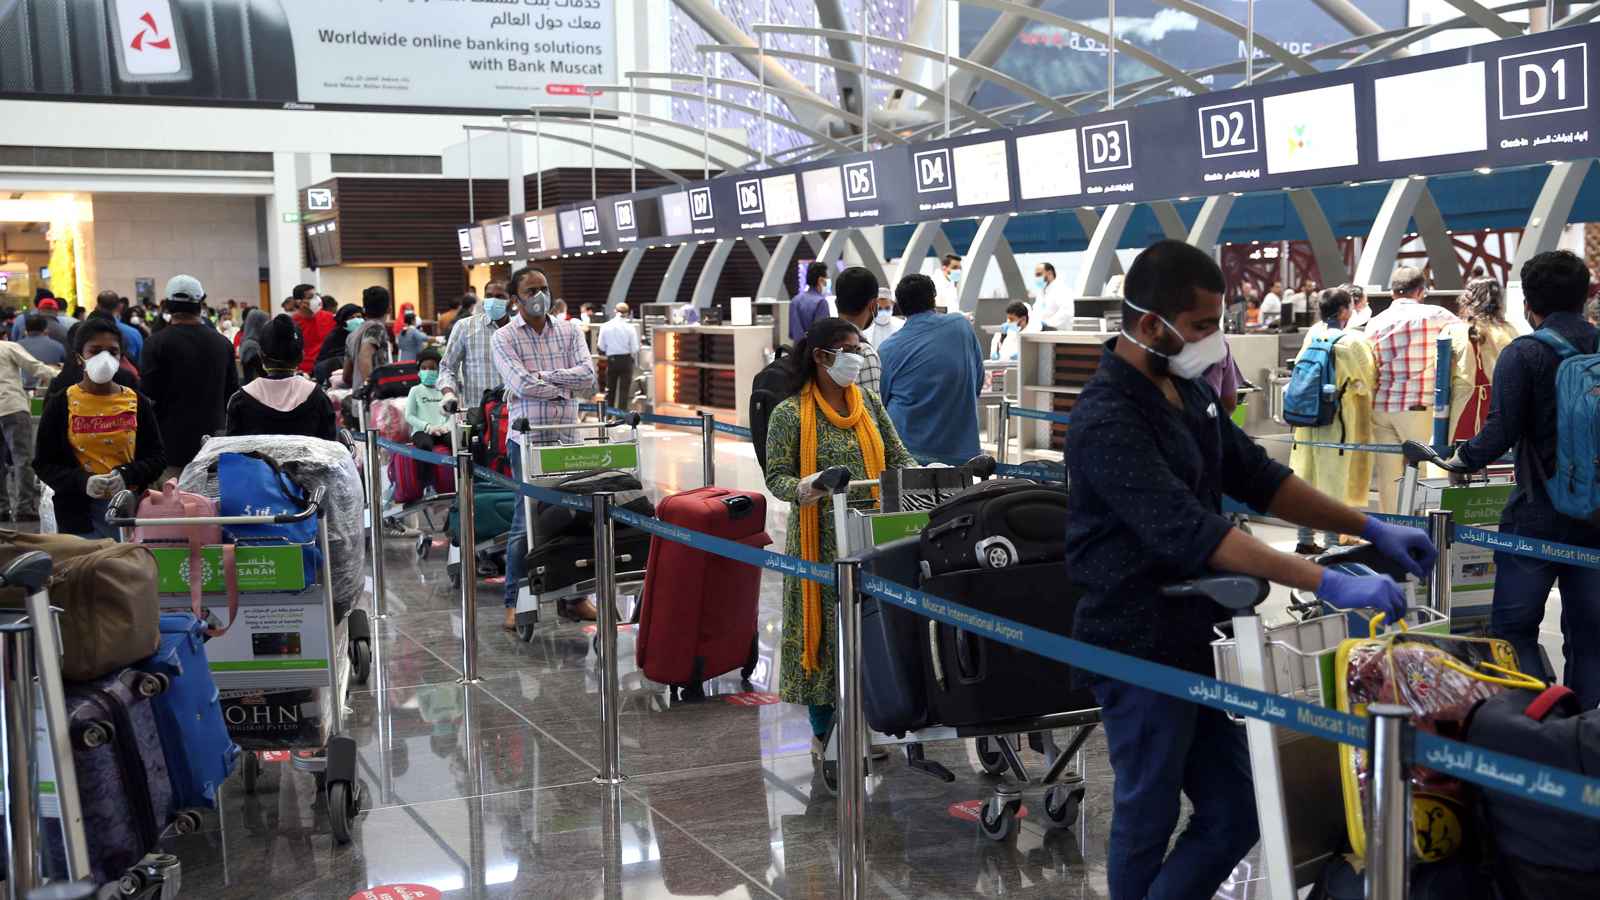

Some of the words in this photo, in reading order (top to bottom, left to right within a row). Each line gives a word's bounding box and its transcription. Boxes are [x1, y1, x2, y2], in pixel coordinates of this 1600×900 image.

[490, 12, 530, 28] العالم
[535, 14, 563, 30] حول
[568, 16, 601, 29] معك
[318, 29, 408, 47] Worldwide
[412, 35, 461, 49] online
[466, 36, 529, 55] banking
[534, 41, 602, 55] solutions
[469, 57, 503, 71] with
[508, 58, 545, 72] Bank
[550, 61, 603, 75] Muscat
[1519, 58, 1566, 106] D1
[1210, 111, 1246, 148] D2
[1092, 131, 1121, 163] D3
[851, 168, 870, 194] D5
[922, 156, 943, 185] D4
[741, 185, 757, 209] D6
[1487, 532, 1512, 547] مسقط
[1514, 539, 1534, 552] مطار
[1541, 543, 1574, 559] Muscat
[218, 567, 276, 576] MSARAH
[883, 586, 902, 600] مسقط
[904, 591, 917, 605] مطار
[922, 597, 946, 615] Muscat
[948, 606, 994, 631] International
[995, 621, 1024, 641] Airport
[1223, 685, 1258, 710] مسقط
[1261, 697, 1287, 718] مطار
[226, 705, 298, 724] OHN
[1297, 706, 1344, 733] Muscat
[1347, 723, 1366, 740] Int
[1474, 753, 1526, 786] مسقط
[1526, 770, 1566, 798] مطار
